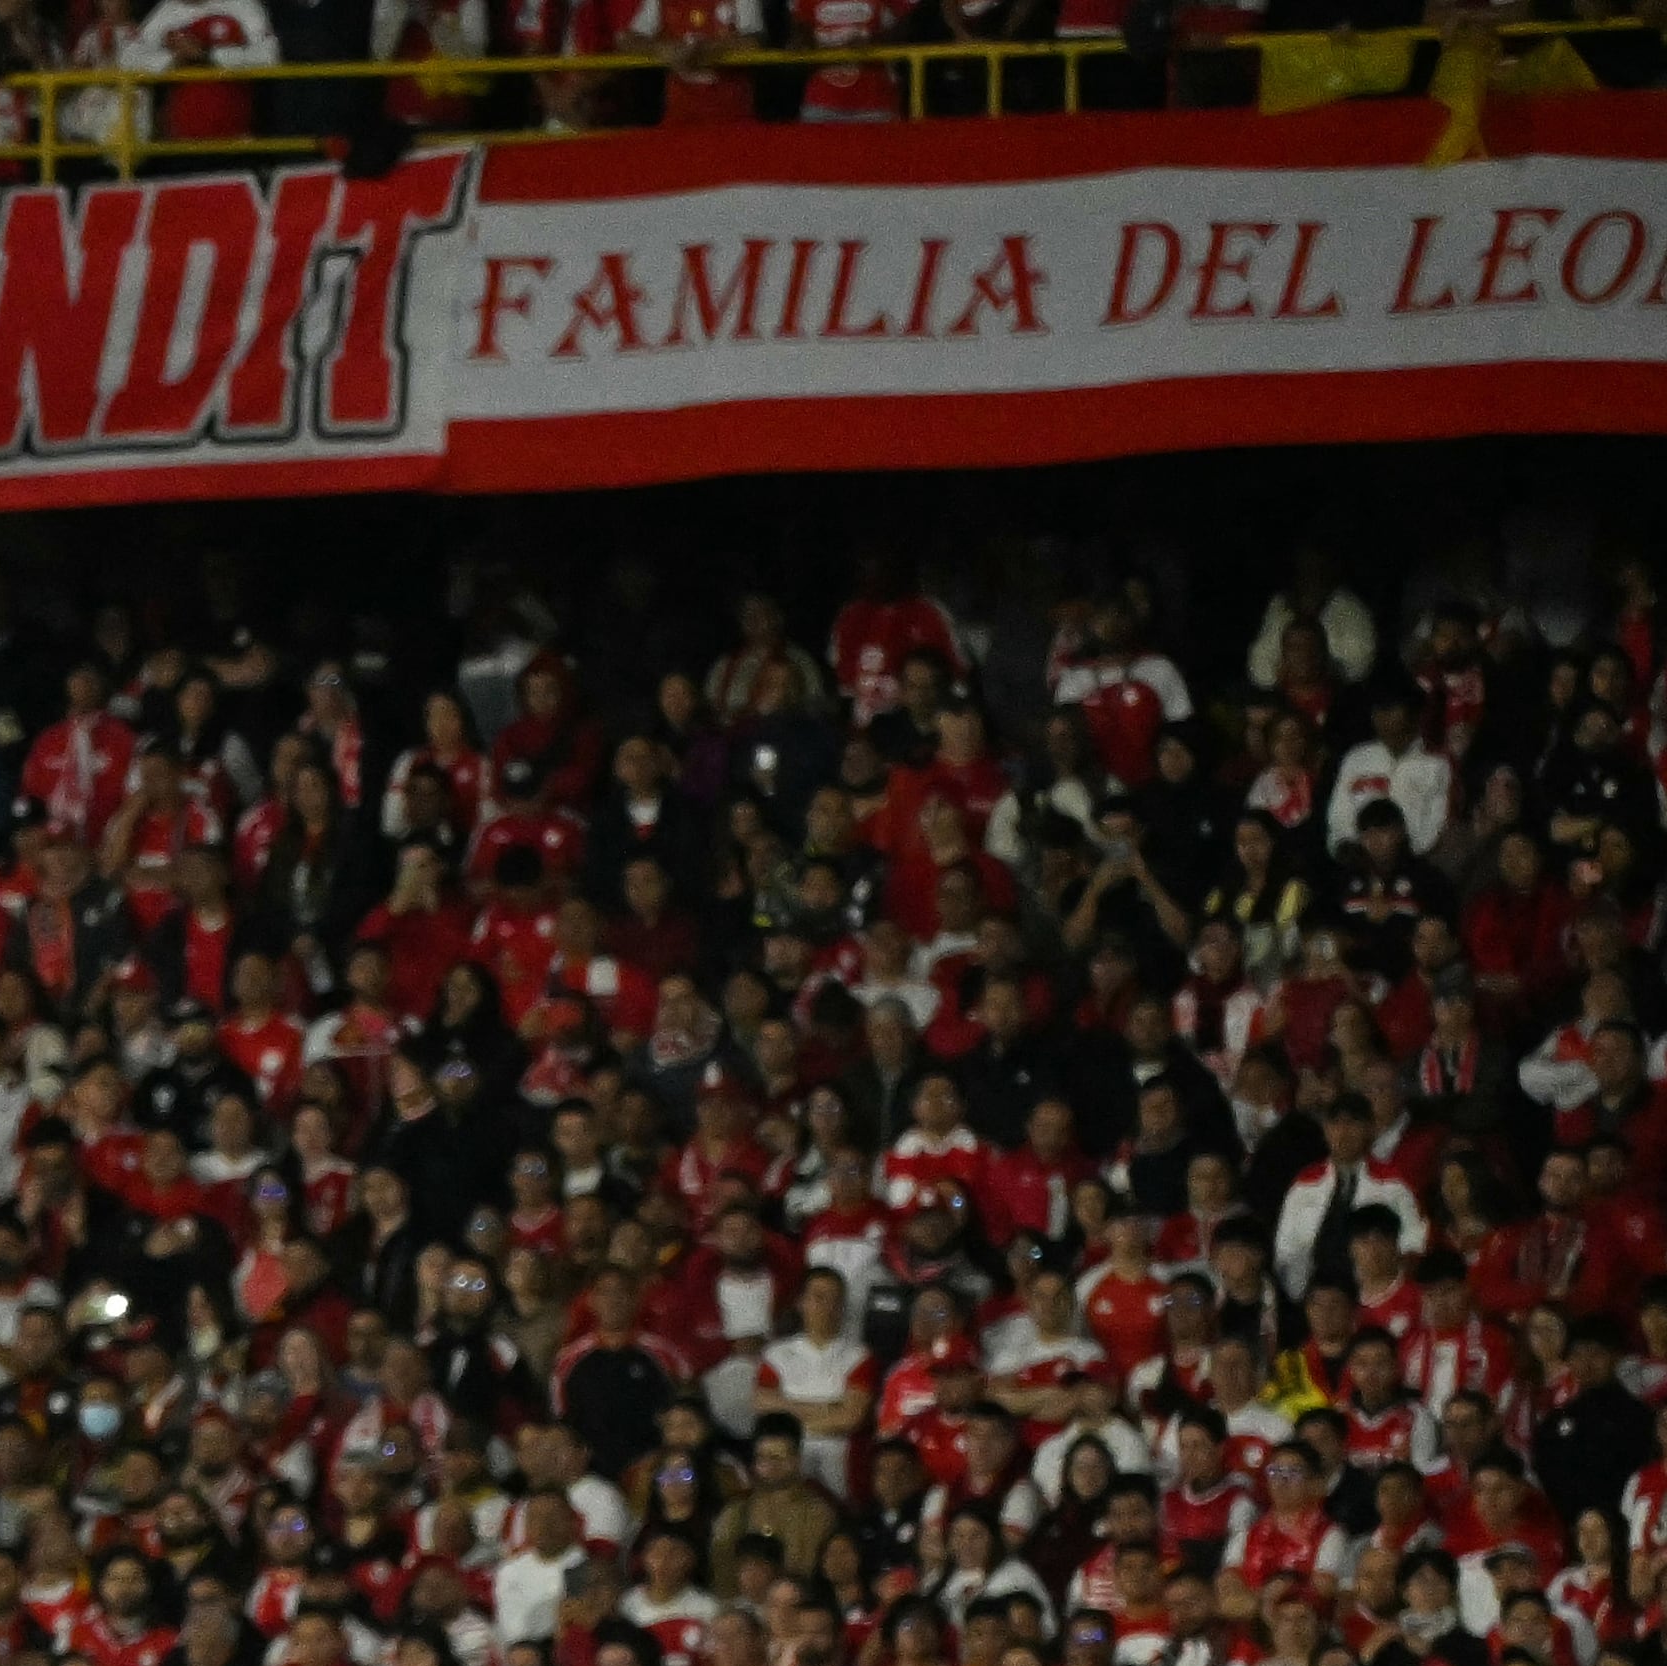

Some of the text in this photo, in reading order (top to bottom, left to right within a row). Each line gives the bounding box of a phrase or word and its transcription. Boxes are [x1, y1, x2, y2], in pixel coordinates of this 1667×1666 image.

[470, 207, 1667, 360] FAMILIA DEL LEO
